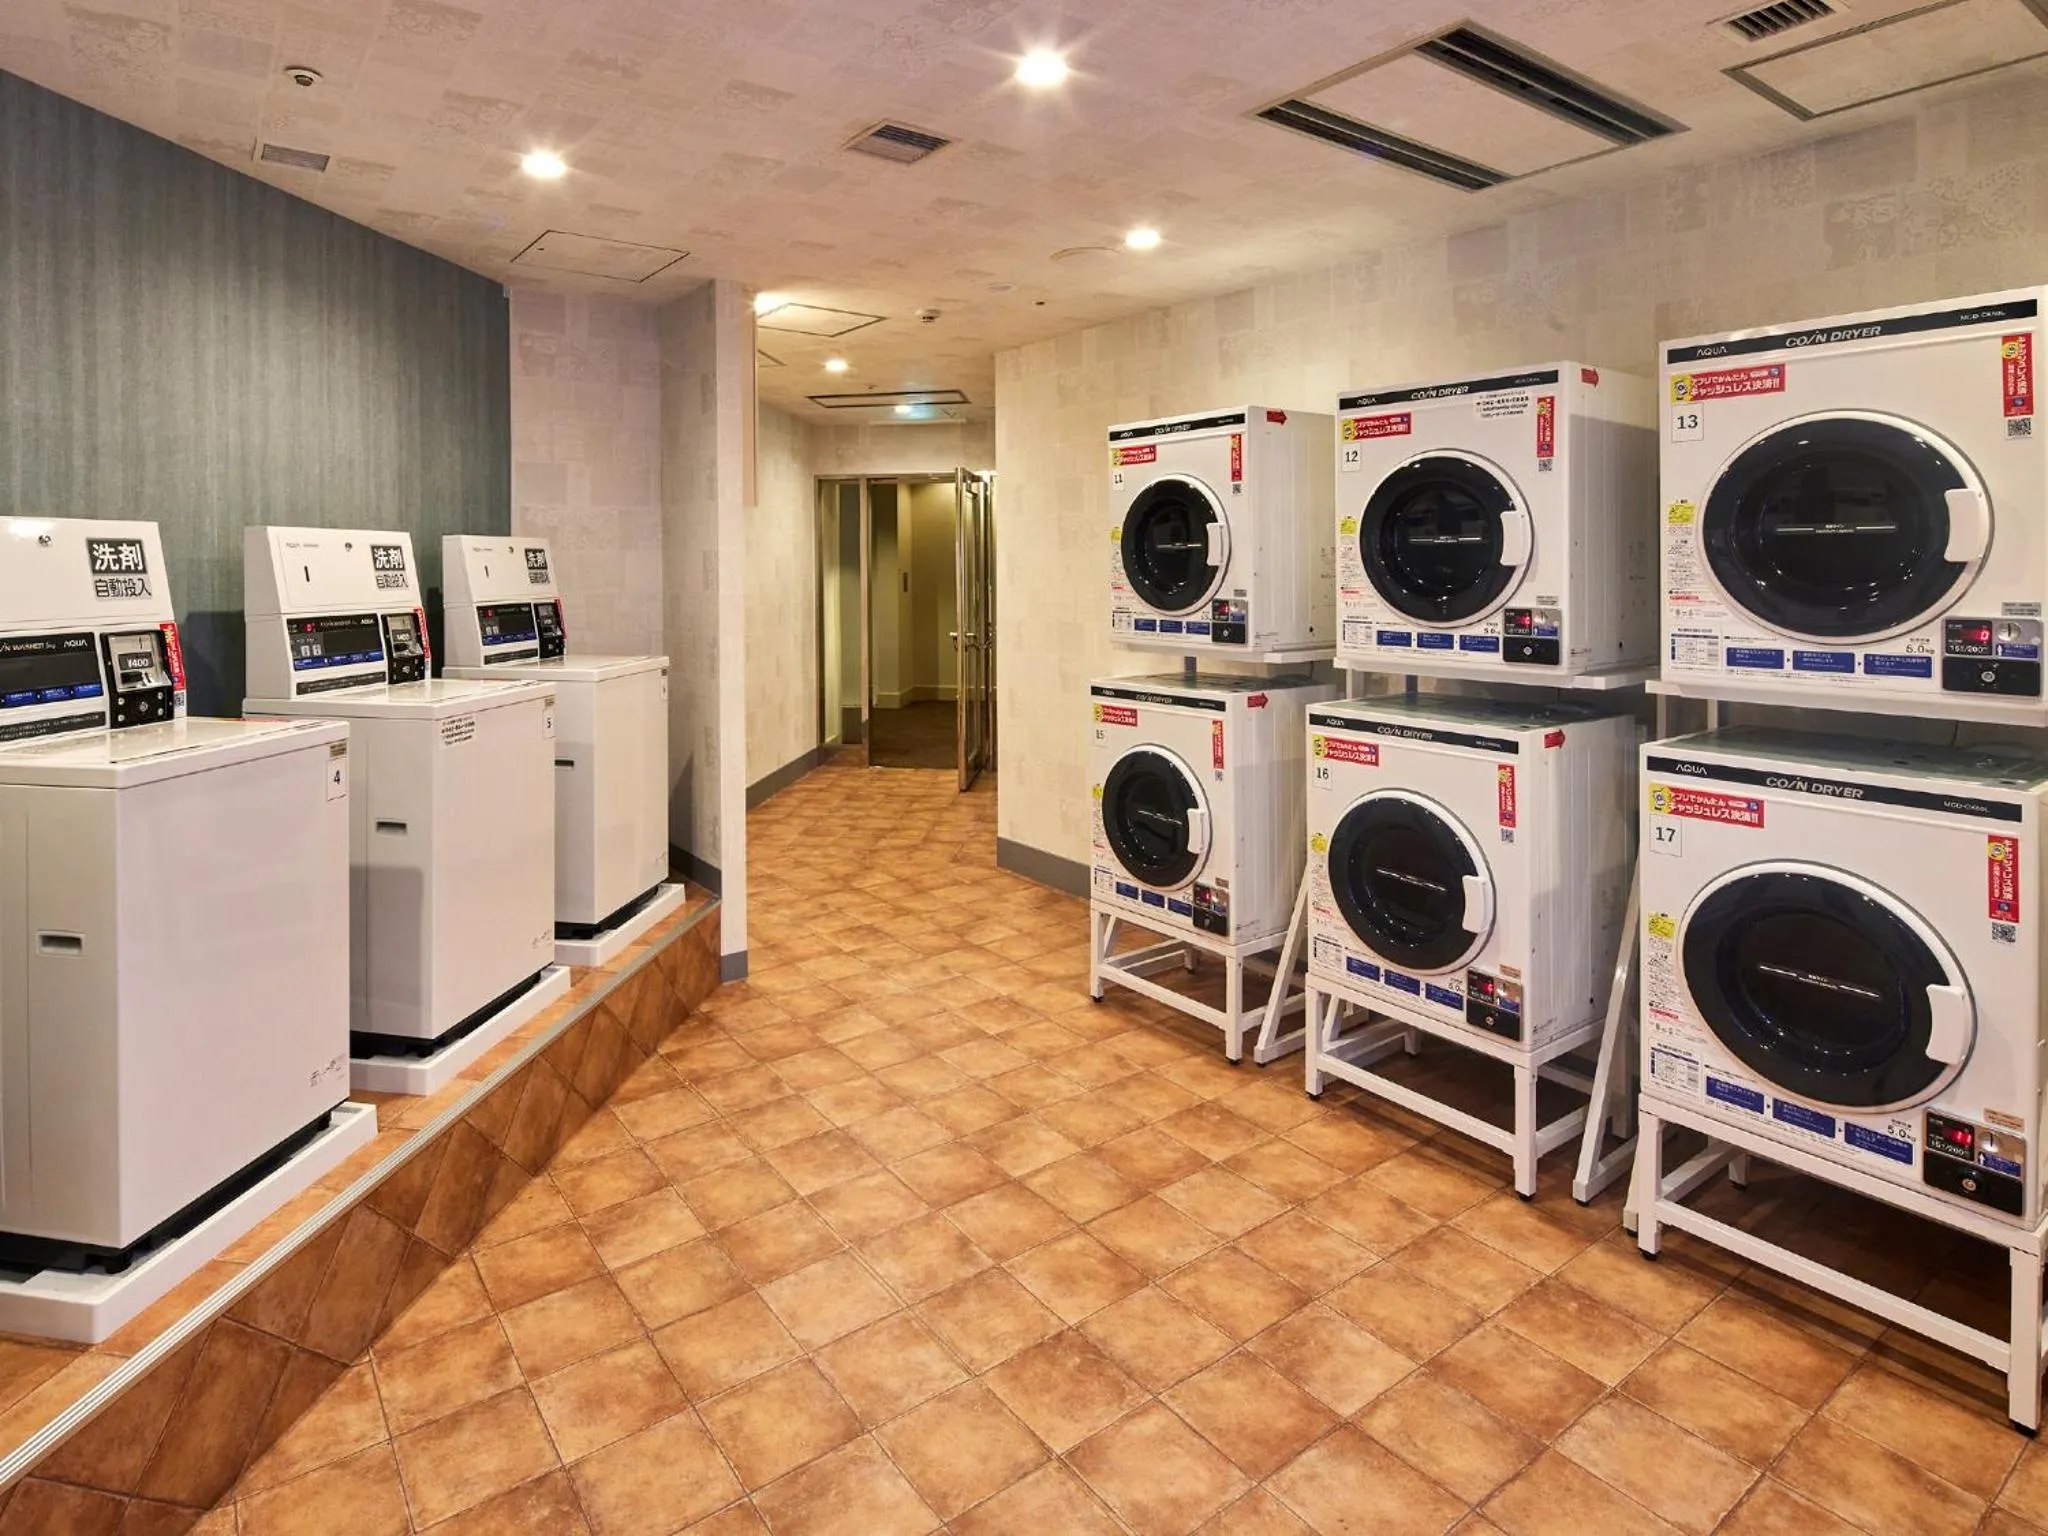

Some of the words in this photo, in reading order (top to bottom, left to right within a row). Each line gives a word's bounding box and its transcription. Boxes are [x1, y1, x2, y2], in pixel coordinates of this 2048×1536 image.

[1830, 325, 1882, 341] DRYER
[1696, 346, 1727, 357] AQUA
[1438, 385, 1470, 397] DRYER
[1676, 414, 1698, 429] 13
[1344, 450, 1359, 463] 12
[93, 542, 144, 571] 洗剤
[374, 547, 404, 569] 洗剤
[94, 577, 152, 598] 自動投入
[63, 639, 88, 648] AQUA
[1326, 718, 1345, 726] AQUA
[1403, 729, 1433, 741] DRYER
[1316, 767, 1330, 780] 16
[1675, 763, 1708, 776] AQUA
[333, 769, 341, 785] 4
[1811, 783, 1865, 799] DRYER
[1656, 826, 1677, 843] 17
